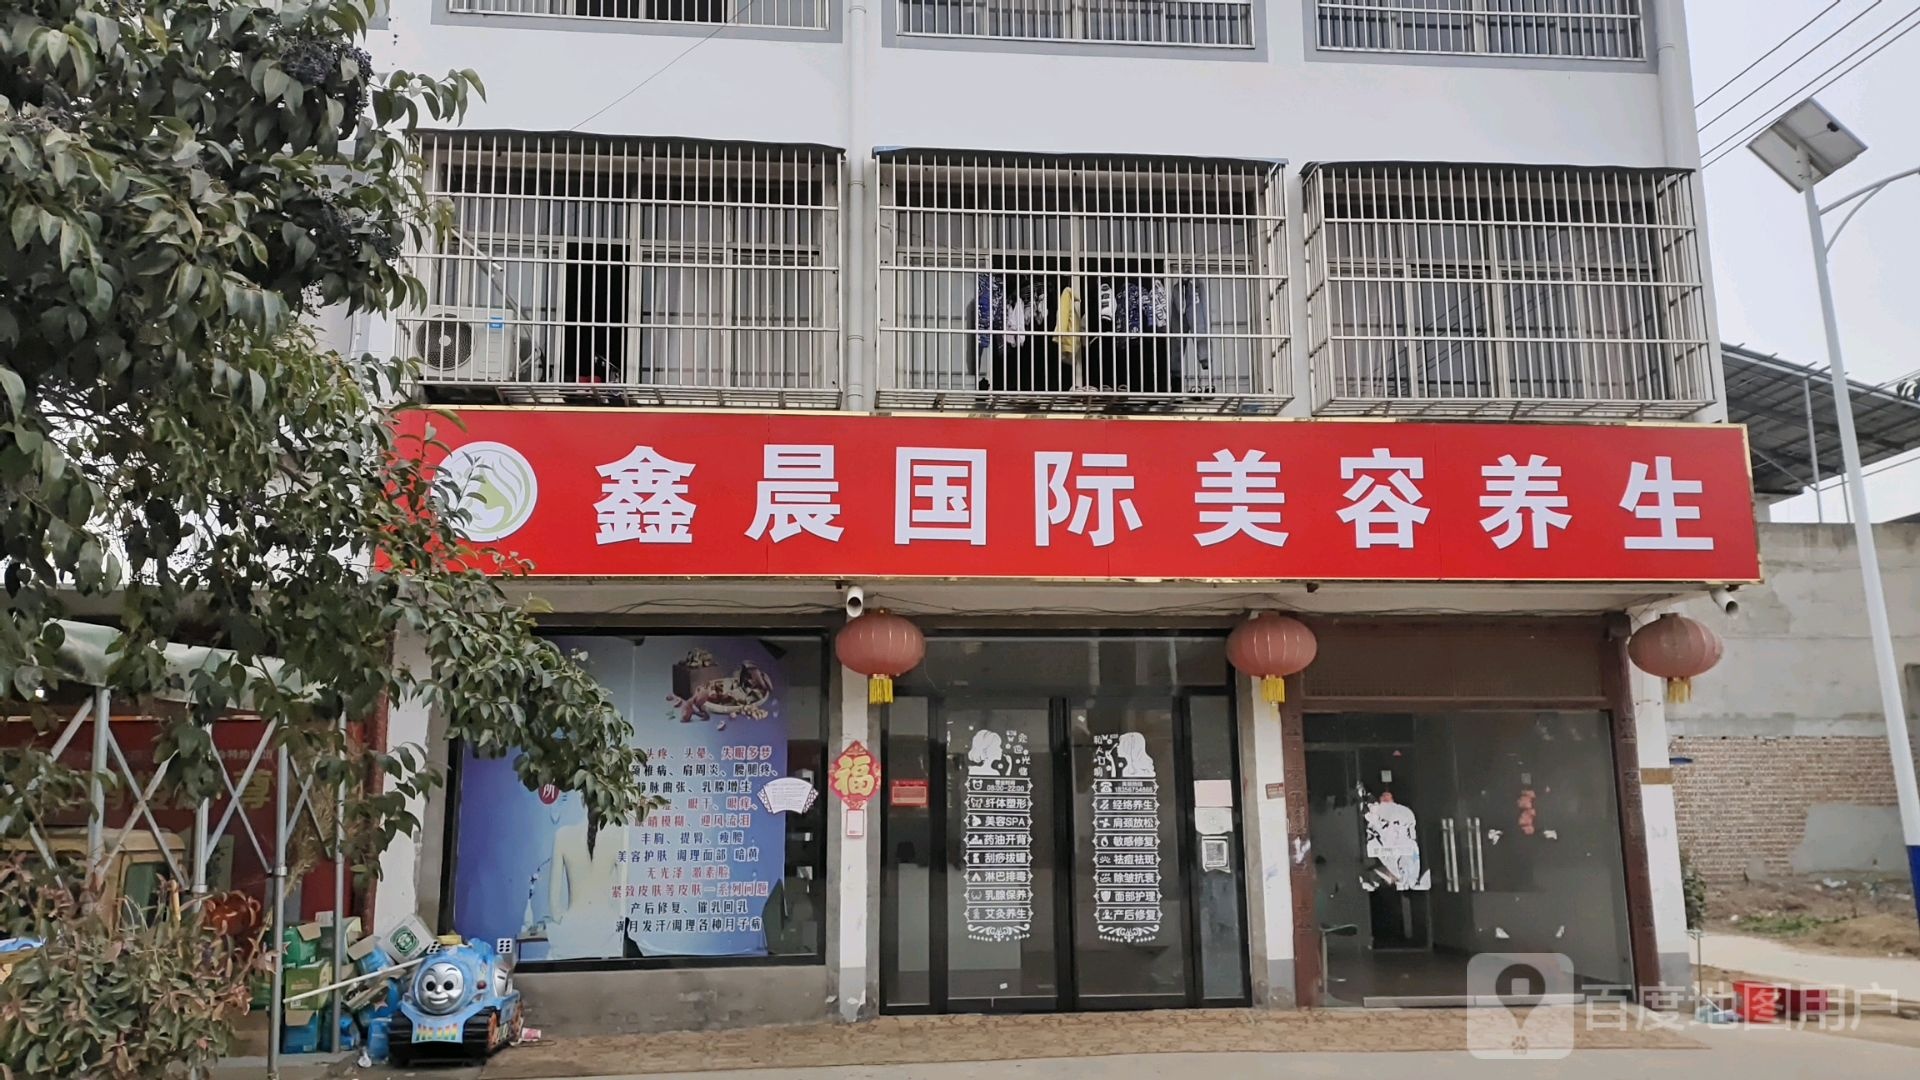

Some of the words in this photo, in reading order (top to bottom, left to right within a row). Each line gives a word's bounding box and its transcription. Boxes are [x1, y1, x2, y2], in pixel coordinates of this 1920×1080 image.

[595, 444, 1714, 550] 鑫晨国际美容养生
[834, 755, 875, 797] 福
[984, 798, 1027, 808] 纤体塑形
[1113, 800, 1153, 810] 经络养生
[985, 816, 1025, 826] 美容SPA
[1113, 818, 1154, 828] 肩颈放松
[984, 834, 1027, 845] 药油开背
[618, 851, 667, 863] 美容护肤
[676, 850, 726, 862] 调理面部
[985, 852, 1027, 863] 刮痧拔罐
[647, 867, 684, 880] 无光泽
[985, 871, 1027, 882] 淋巴排毒
[985, 890, 1027, 901] 乳腺保养
[1114, 891, 1155, 901] 面部护理
[985, 908, 1027, 920] 艾灸养生
[1114, 909, 1156, 920] 产后修复
